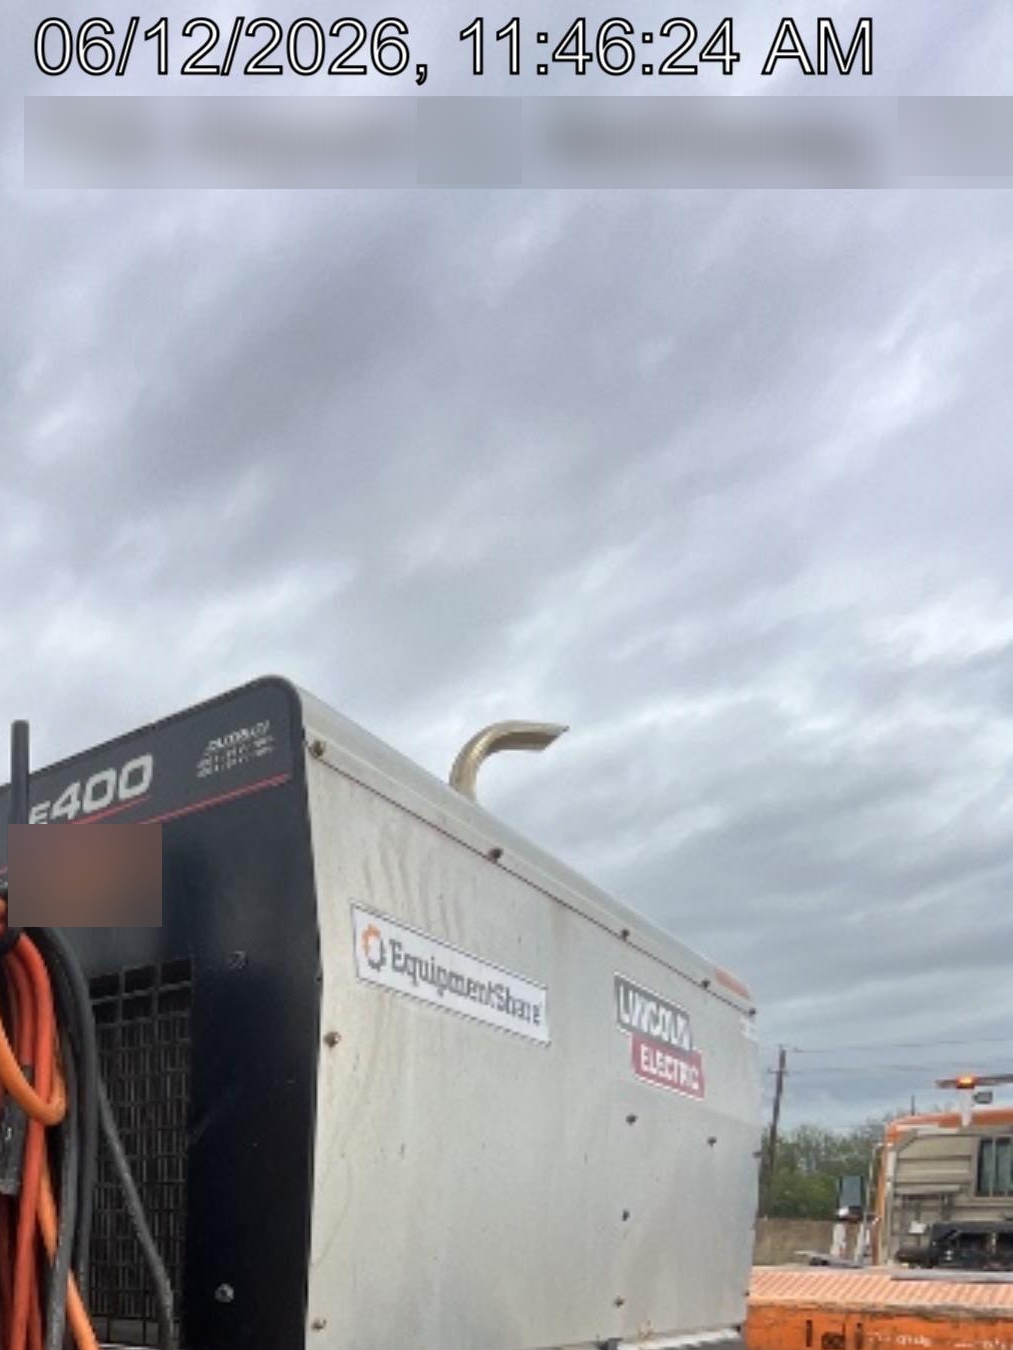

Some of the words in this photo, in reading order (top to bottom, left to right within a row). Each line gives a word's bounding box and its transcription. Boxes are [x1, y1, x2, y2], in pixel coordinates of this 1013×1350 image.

[389, 938, 541, 1026] EquipmentShare
[619, 985, 690, 1051] LINCOLN
[640, 1043, 700, 1090] ELECTRIC
